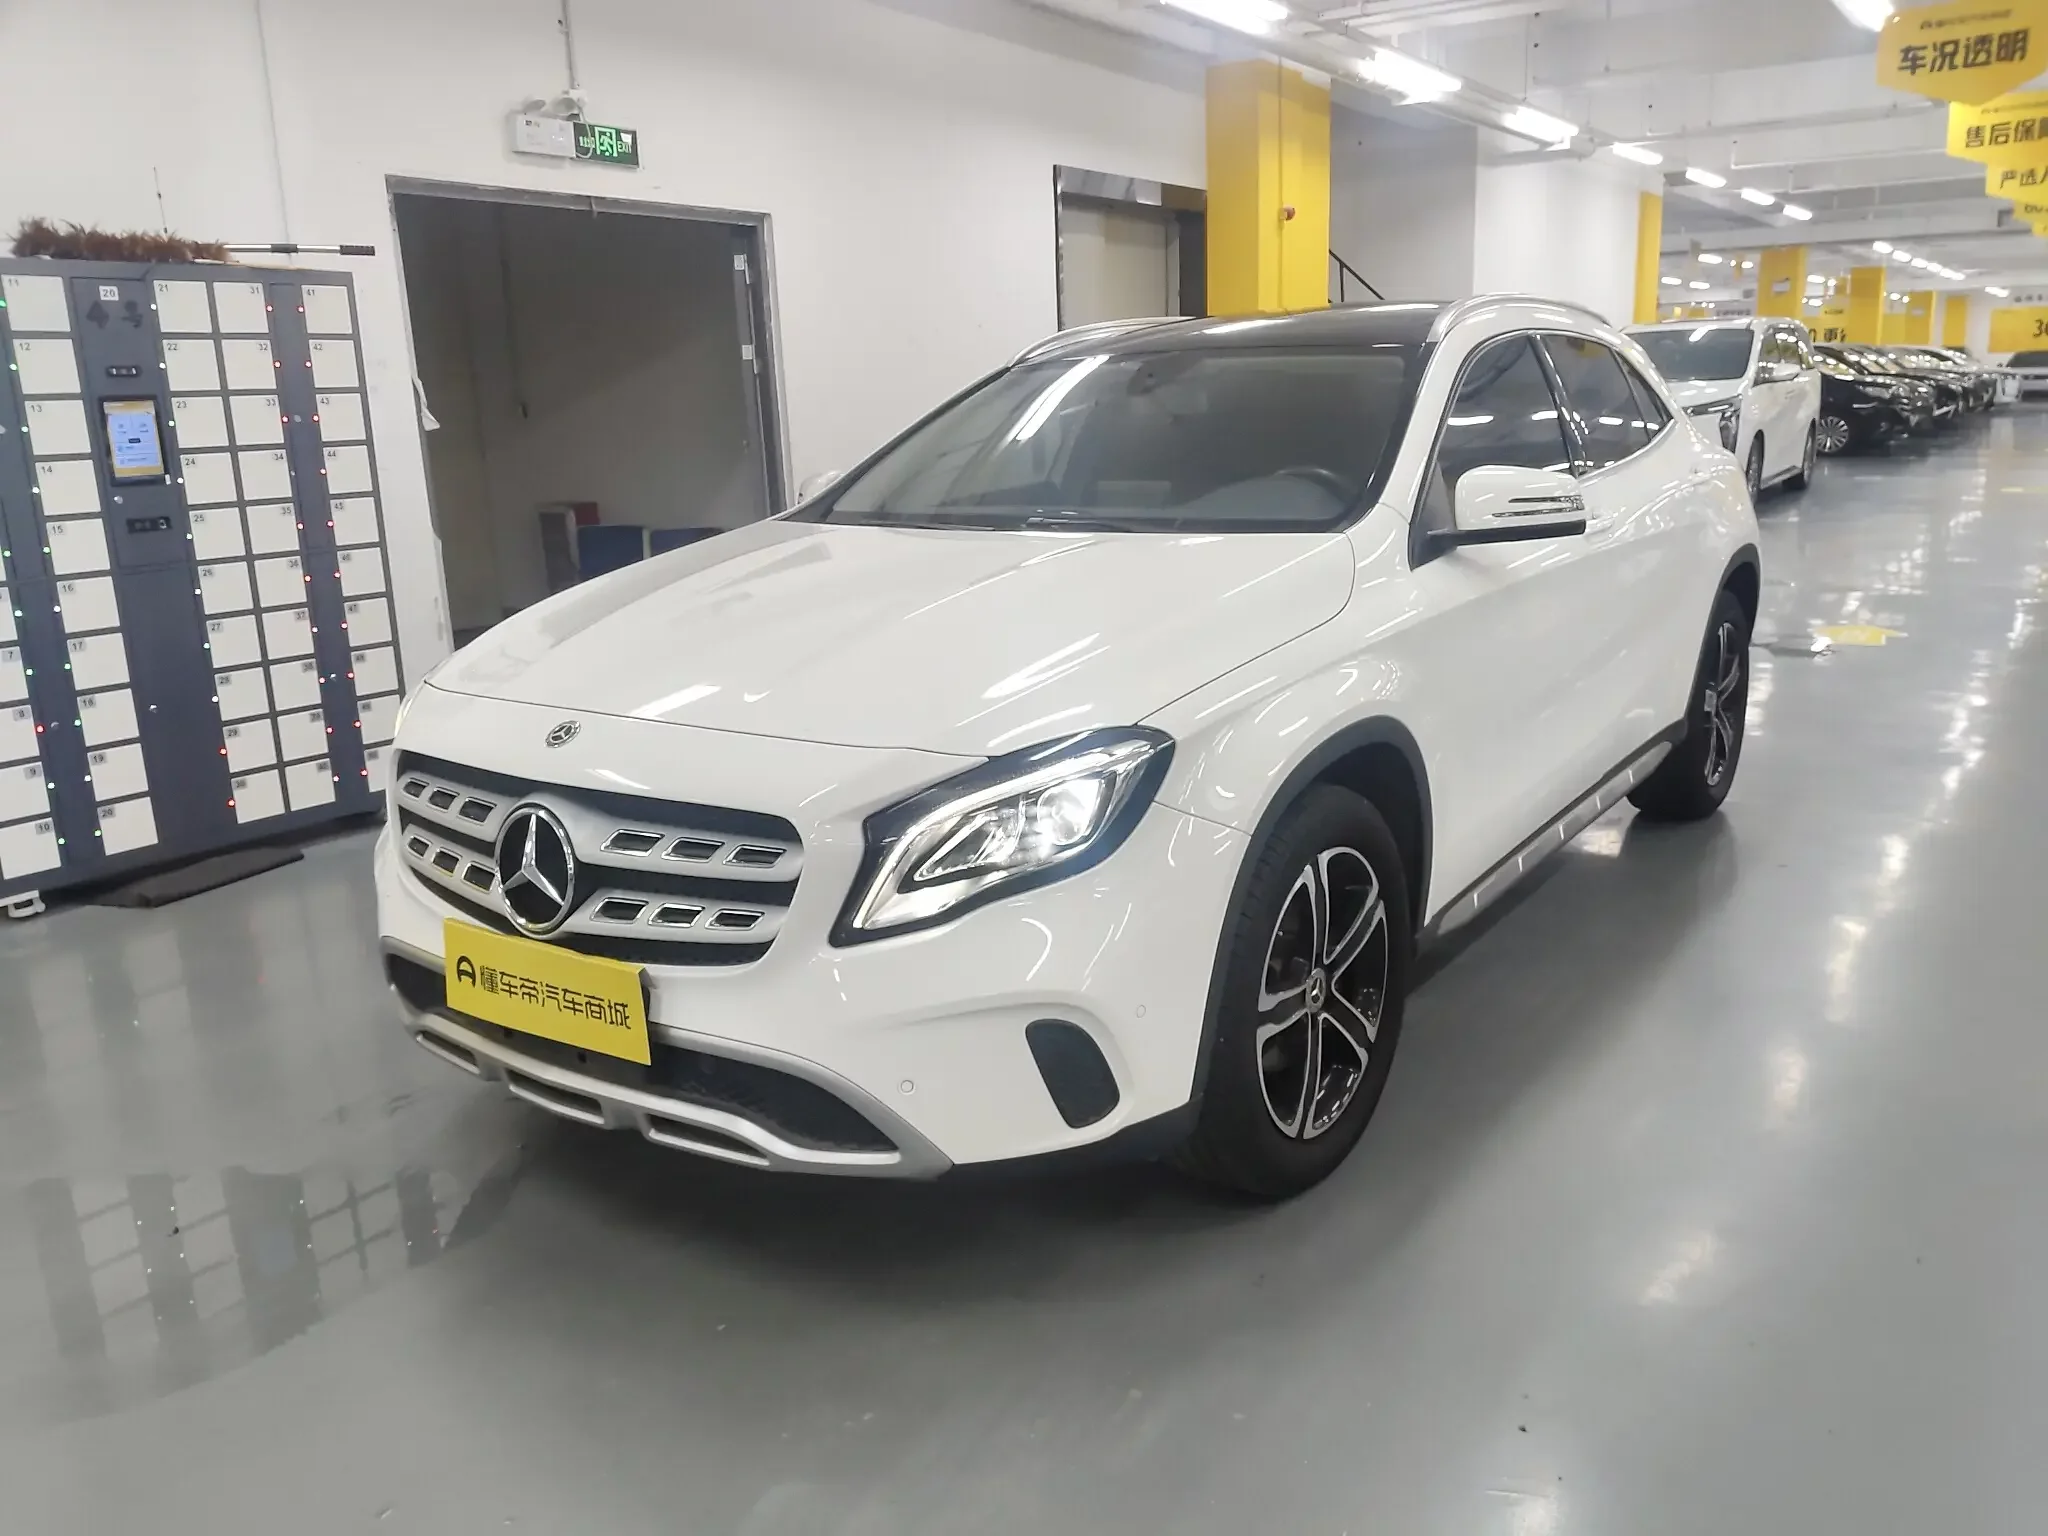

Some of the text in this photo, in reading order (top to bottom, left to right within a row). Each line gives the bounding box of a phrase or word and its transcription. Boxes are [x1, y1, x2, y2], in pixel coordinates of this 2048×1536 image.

[1898, 28, 2029, 76] 车况透明
[158, 283, 170, 292] 21
[249, 285, 261, 294] 31
[103, 288, 117, 298] 20
[306, 288, 316, 297] 41
[19, 342, 31, 351] 12
[166, 343, 178, 351] 22
[258, 342, 269, 351] 32
[313, 342, 323, 351] 42
[185, 457, 197, 466] 24
[41, 465, 53, 475] 14
[193, 514, 205, 523] 25
[52, 525, 64, 535] 15
[62, 584, 74, 593] 16
[211, 623, 222, 631] 27
[72, 641, 84, 651] 17
[8, 651, 14, 660] 7
[30, 768, 37, 777] 9
[102, 808, 113, 818] 20
[38, 823, 50, 832] 10
[479, 964, 632, 1030] 懂车帝汽车商城
